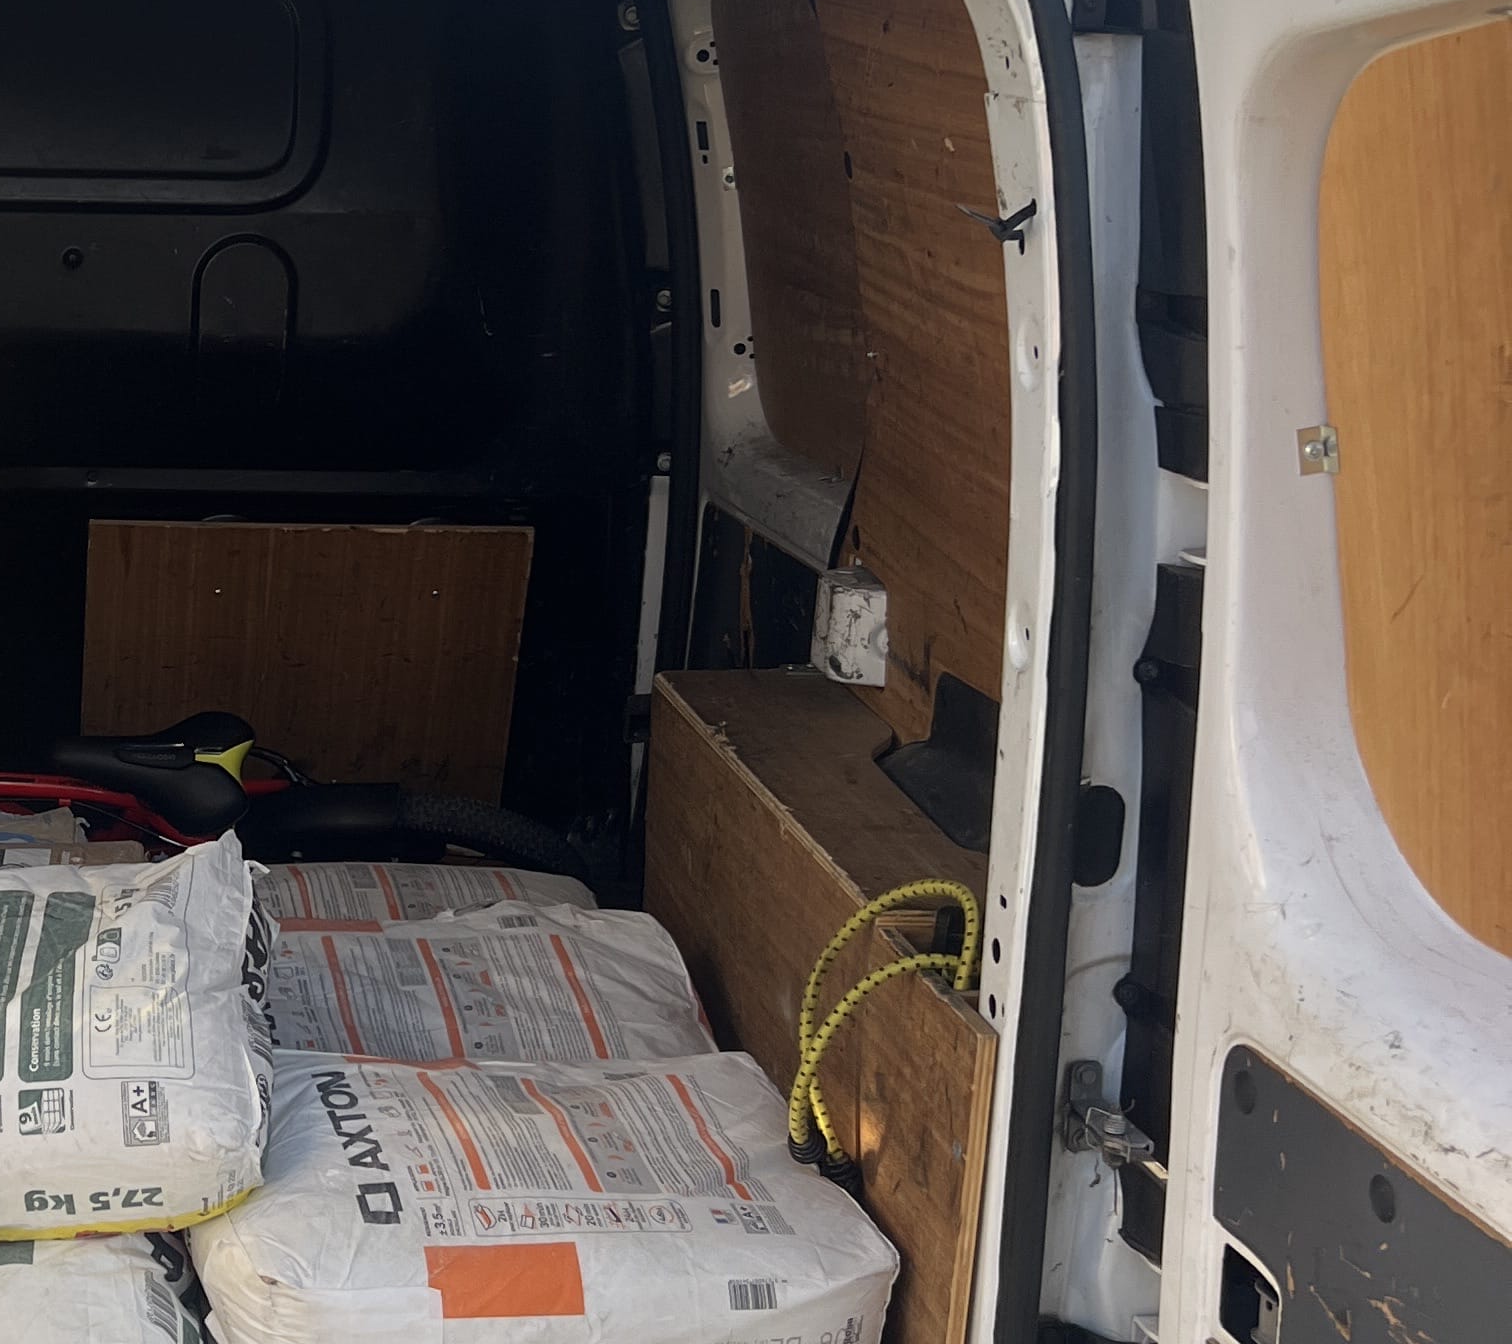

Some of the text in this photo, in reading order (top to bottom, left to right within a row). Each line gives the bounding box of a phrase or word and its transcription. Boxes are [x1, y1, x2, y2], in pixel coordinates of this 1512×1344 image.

[29, 1008, 41, 1072] Conservation
[132, 1086, 146, 1114] A+
[311, 1071, 391, 1172] AXTON
[24, 1187, 164, 1215] 27,5 kg
